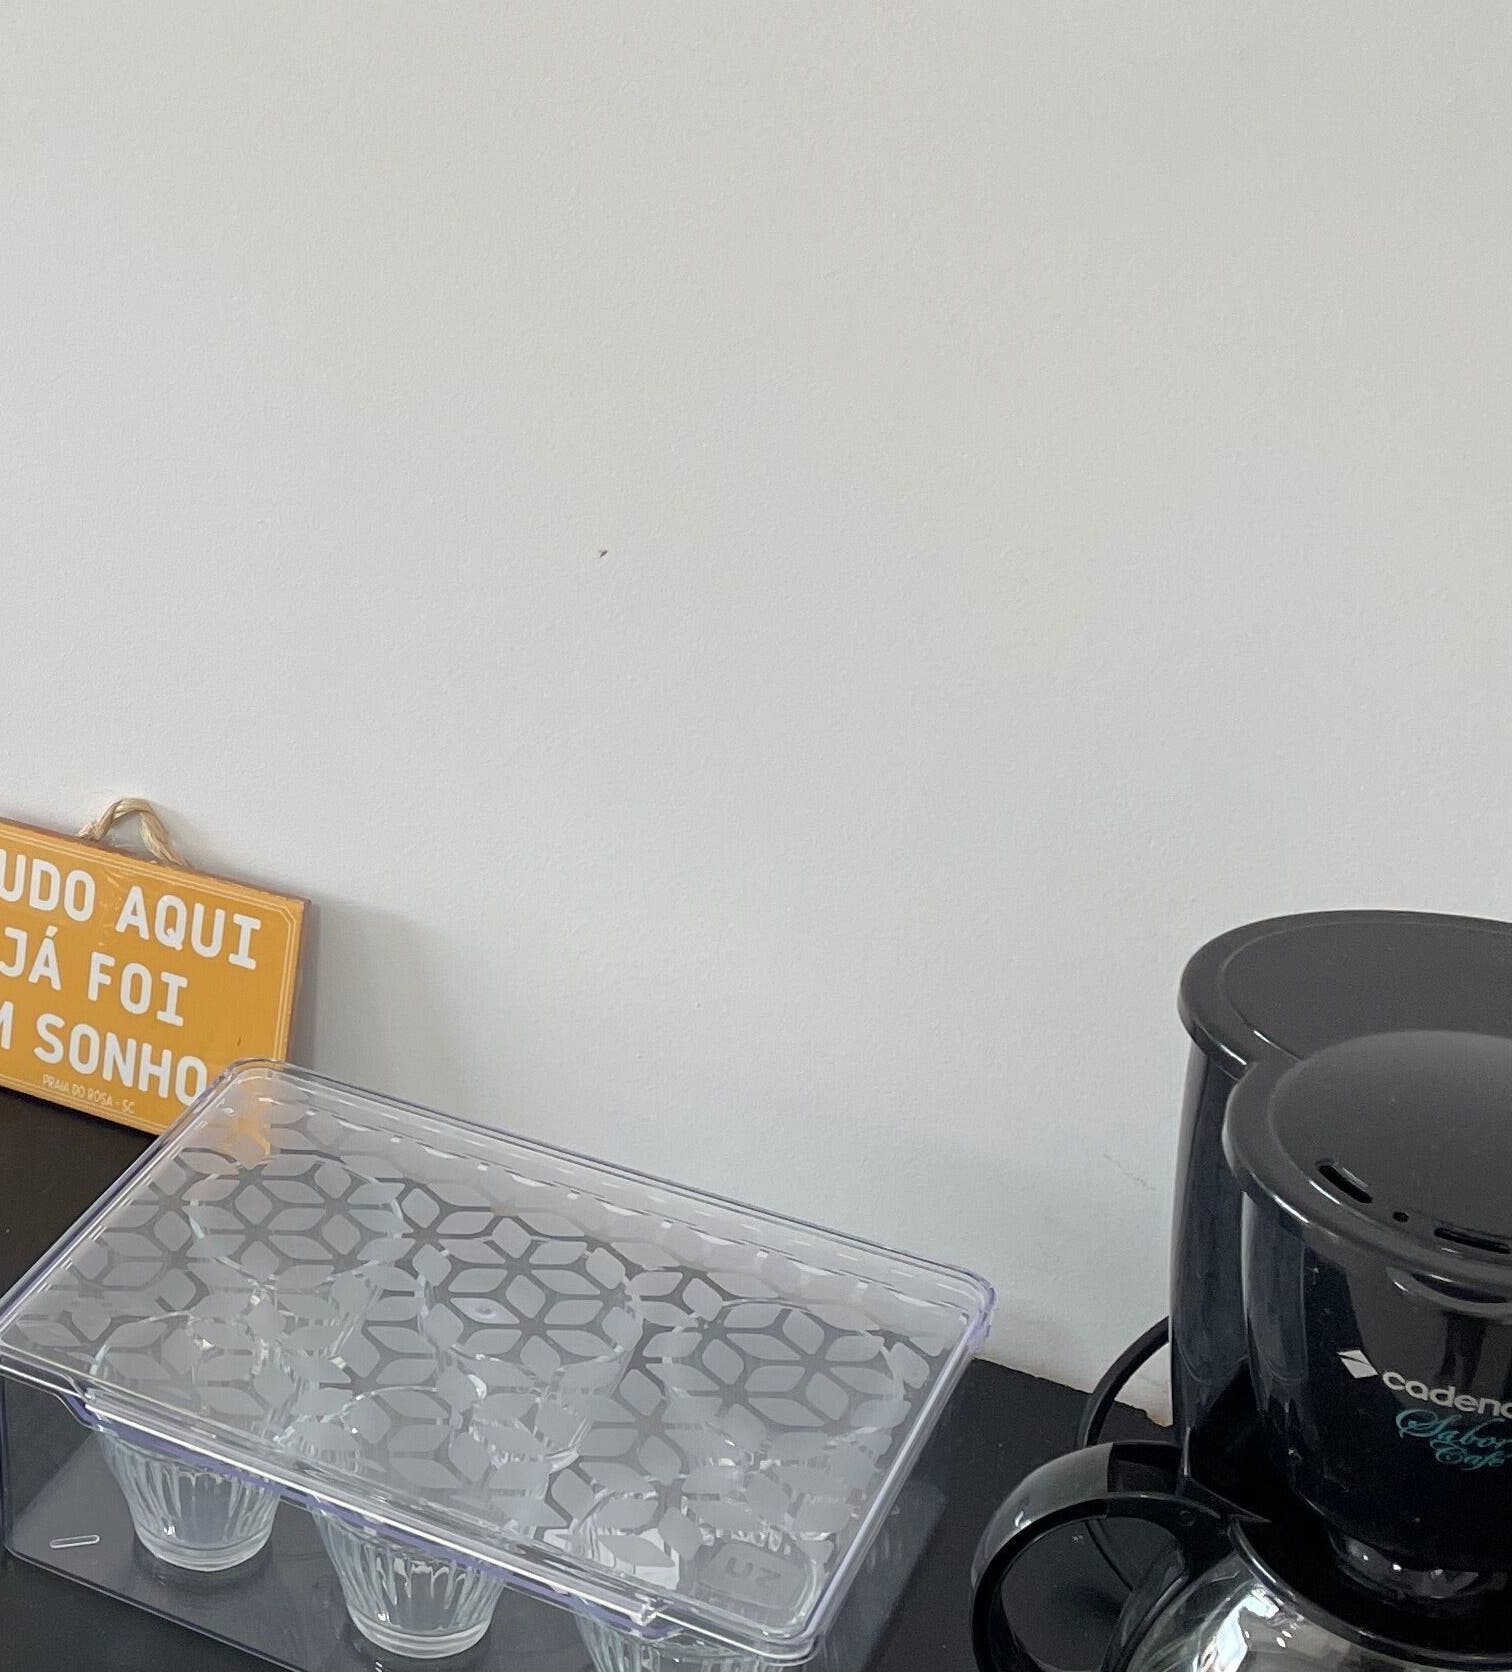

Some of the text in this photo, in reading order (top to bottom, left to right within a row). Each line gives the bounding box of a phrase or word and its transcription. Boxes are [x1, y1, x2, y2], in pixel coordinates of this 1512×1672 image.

[115, 885, 263, 971] AQUI
[88, 951, 188, 1027] FOI
[33, 1013, 207, 1106] SONHO
[43, 1073, 69, 1093] PRAIA
[71, 1083, 86, 1098] DO
[88, 1087, 112, 1106] ROSA
[121, 1100, 135, 1113] SC
